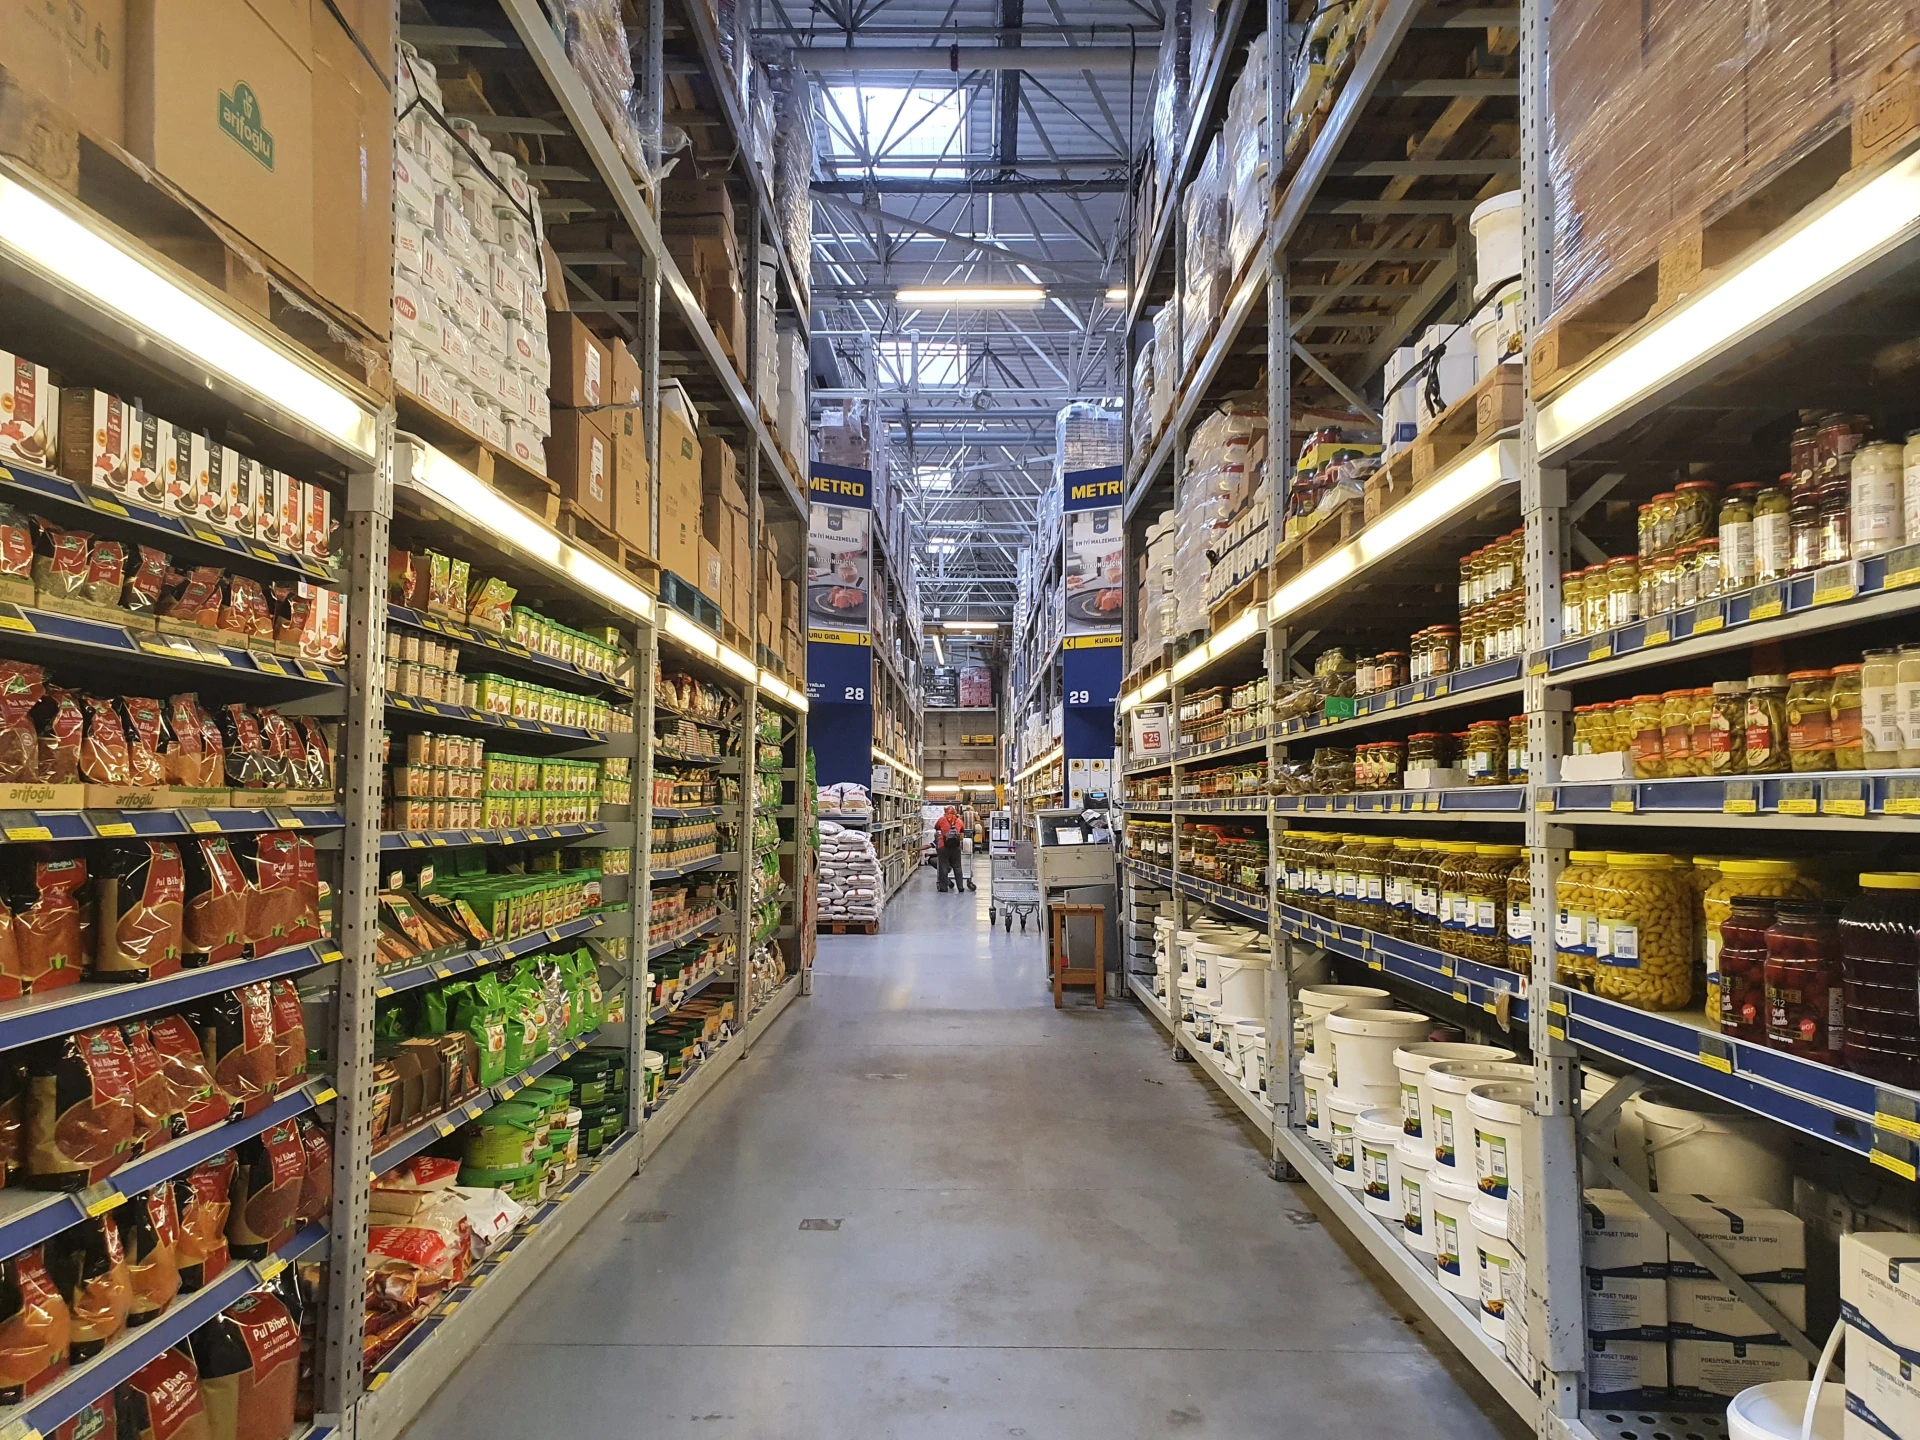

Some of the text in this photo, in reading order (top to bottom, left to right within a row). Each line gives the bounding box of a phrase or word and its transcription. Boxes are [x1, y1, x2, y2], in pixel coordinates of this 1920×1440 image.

[223, 106, 270, 158] arifoğlu
[809, 477, 864, 497] METRO
[844, 686, 865, 700] 28
[1069, 690, 1089, 704] 29
[1149, 732, 1160, 742] 25
[9, 786, 55, 803] arifoğlu
[116, 793, 154, 809] arifoğlu
[1743, 1007, 1755, 1015] HOT
[1772, 998, 1786, 1008] 212
[1801, 1022, 1814, 1030] HOT
[419, 1155, 434, 1178] PAN
[370, 1227, 406, 1256] PANKO
[1861, 1268, 1894, 1293] PORSİYONLUK
[253, 1315, 289, 1342] Pul Biber
[1701, 1357, 1741, 1365] PORSİYONLUK
[164, 1370, 189, 1392] Biber
[1868, 1361, 1906, 1389] PORSİYONLUK
